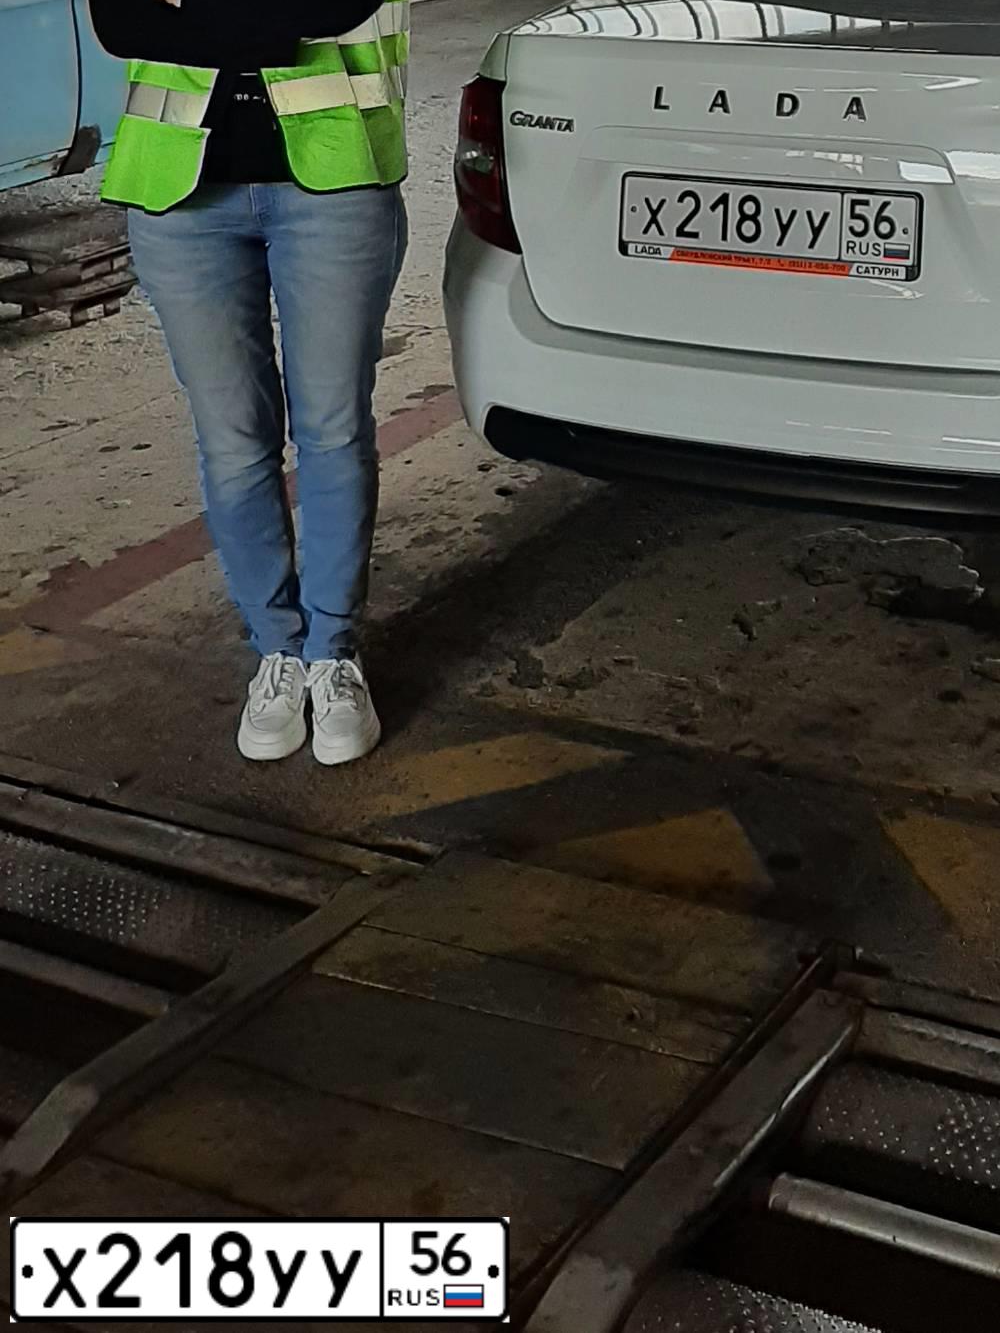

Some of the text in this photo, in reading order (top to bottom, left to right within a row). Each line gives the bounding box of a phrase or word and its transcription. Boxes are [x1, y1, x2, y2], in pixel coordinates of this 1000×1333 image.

[653, 85, 868, 123] LADA
[508, 110, 575, 133] GRANTA
[847, 198, 897, 240] 56
[633, 244, 662, 256] LADA
[845, 239, 882, 258] RUS
[855, 265, 900, 277] САТУРН
